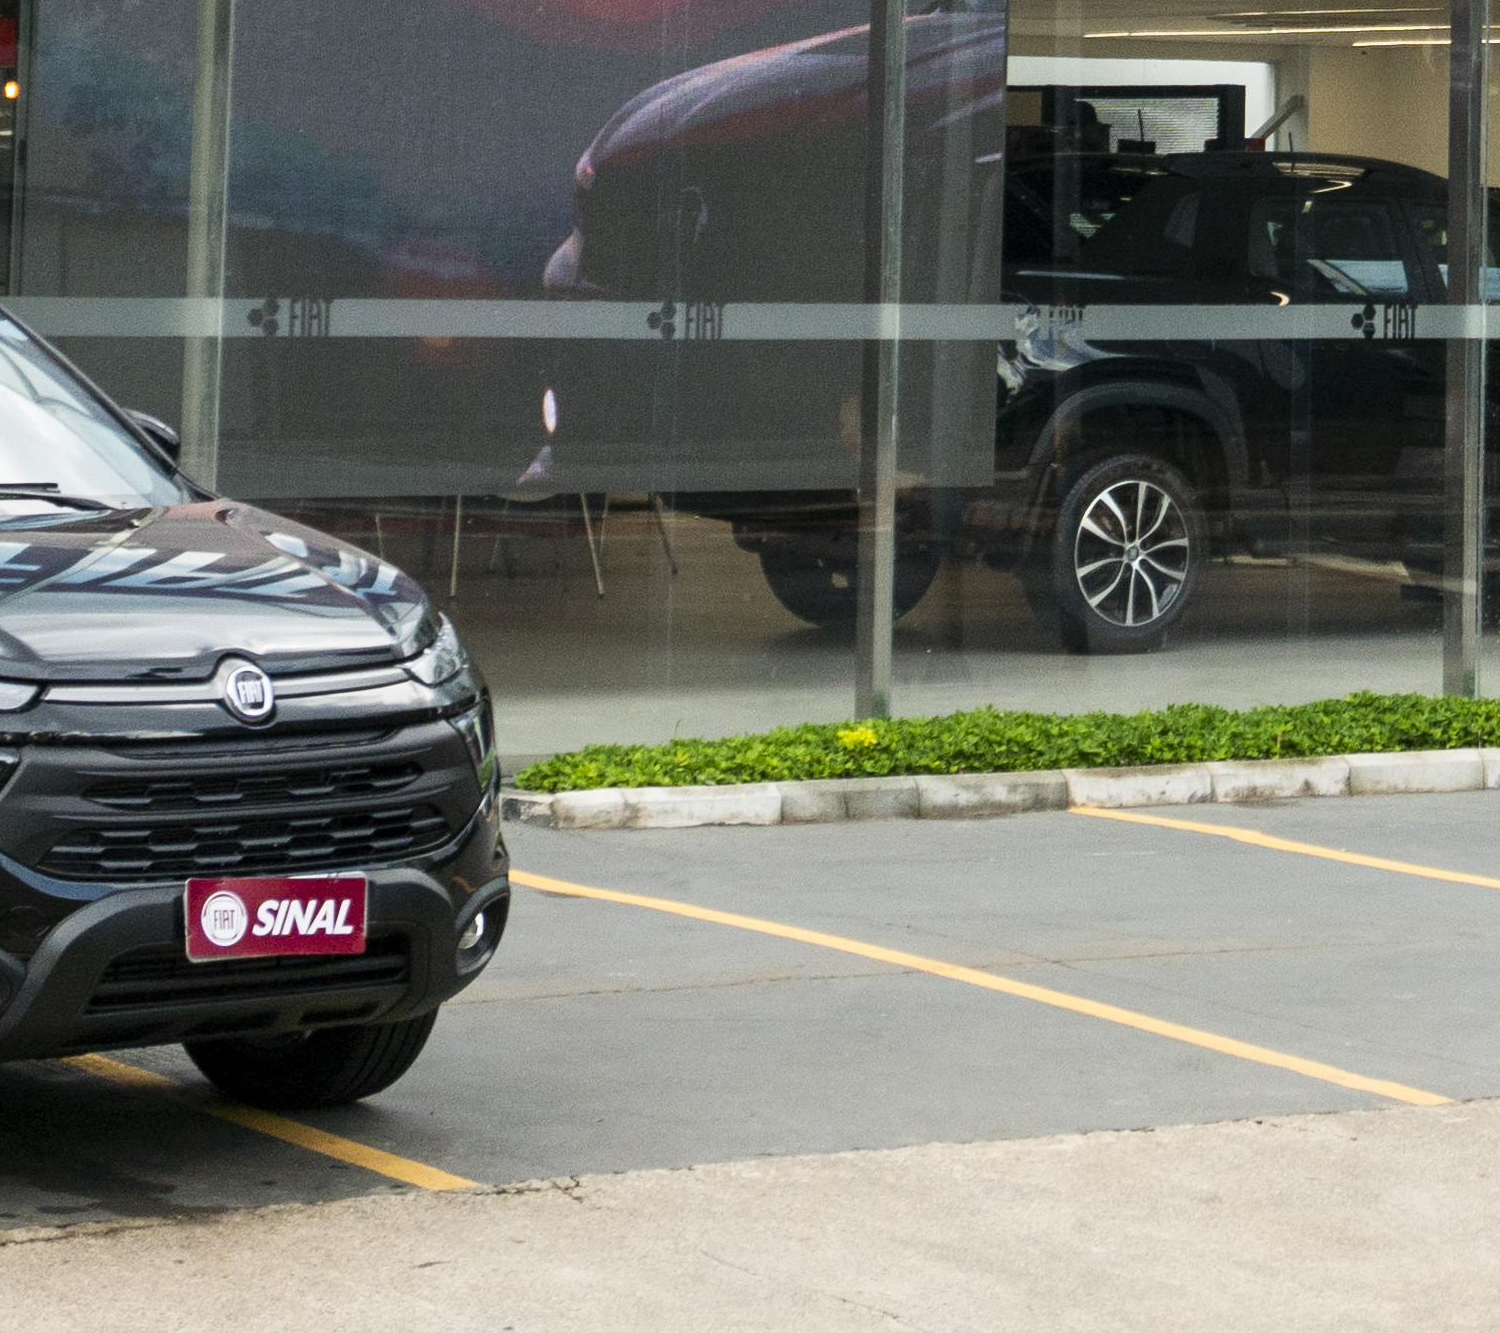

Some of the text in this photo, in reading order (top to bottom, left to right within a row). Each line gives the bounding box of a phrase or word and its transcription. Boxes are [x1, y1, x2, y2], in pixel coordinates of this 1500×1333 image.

[288, 296, 333, 337] FIAT
[685, 301, 724, 340] FIAT
[1383, 302, 1418, 339] FIAT
[236, 680, 264, 705] FIAT
[213, 898, 354, 937] FIAT SINAL
